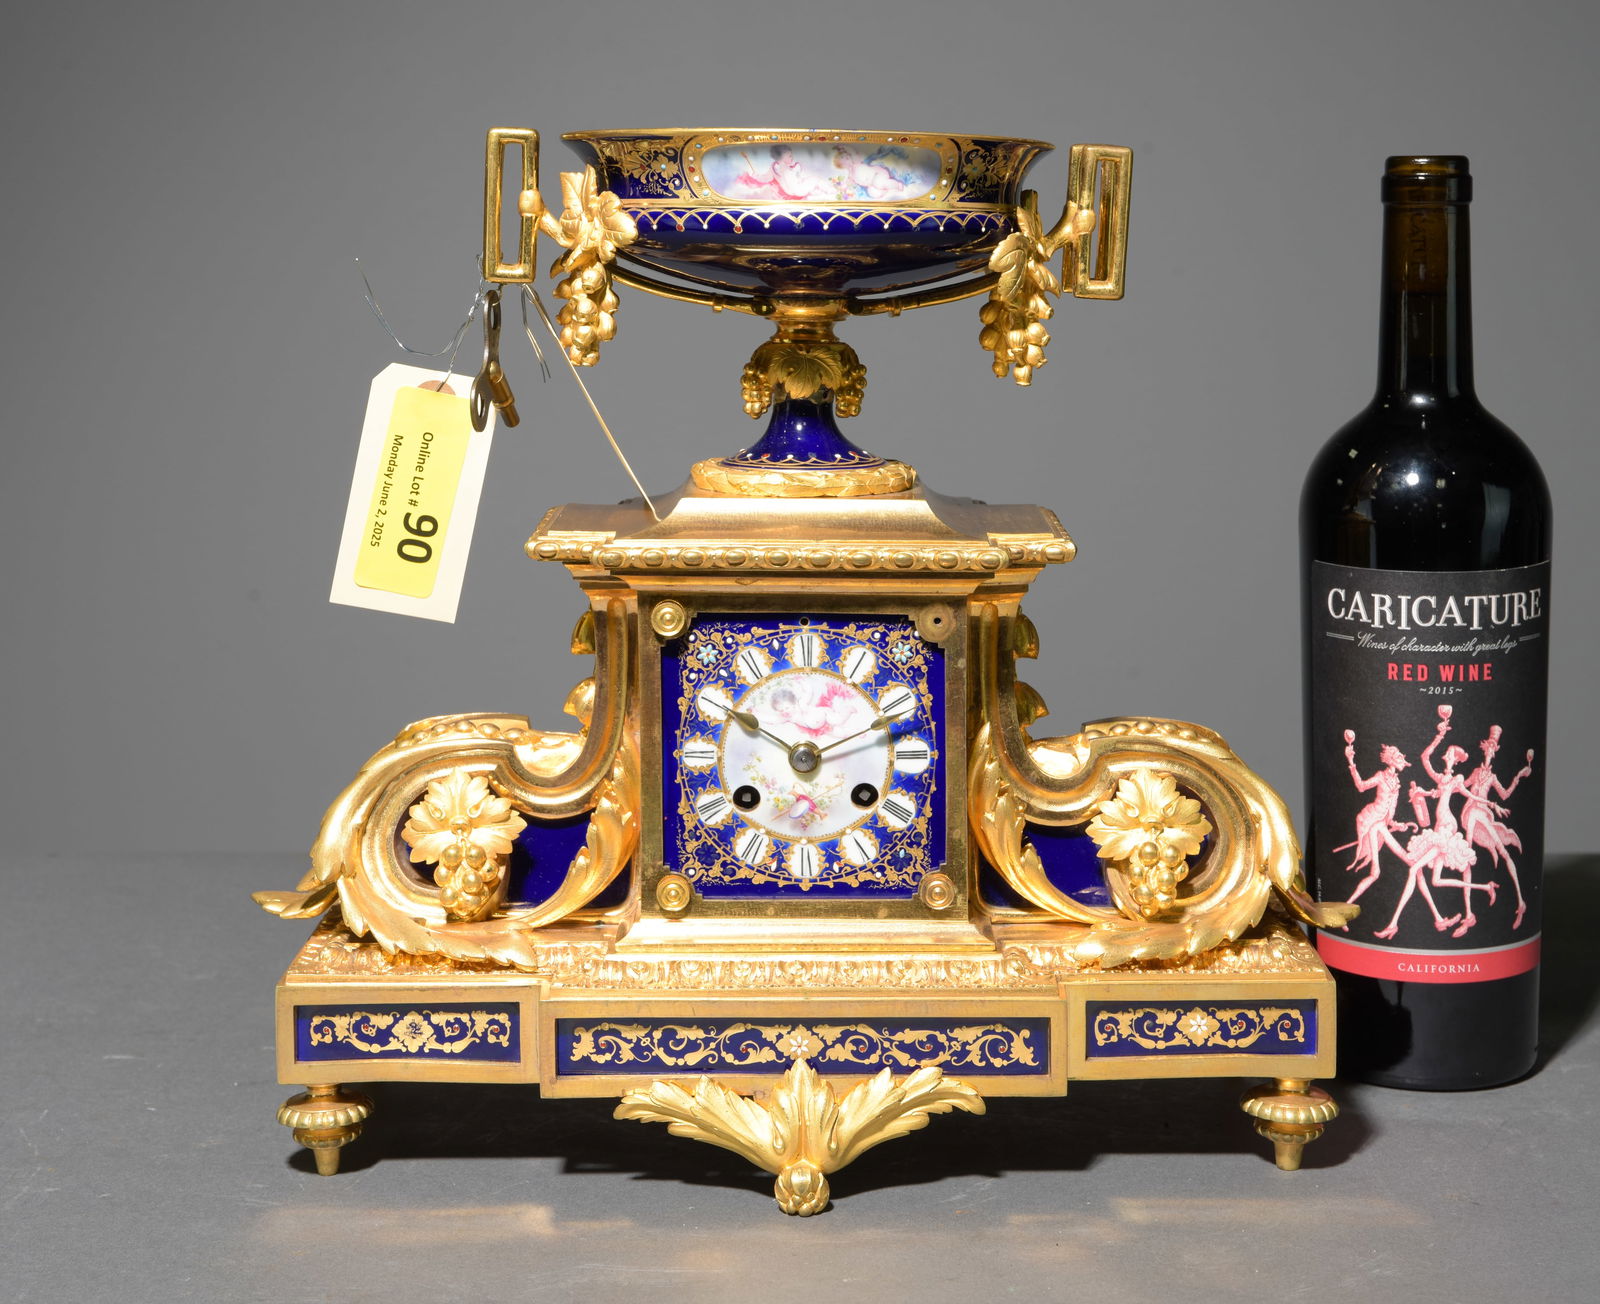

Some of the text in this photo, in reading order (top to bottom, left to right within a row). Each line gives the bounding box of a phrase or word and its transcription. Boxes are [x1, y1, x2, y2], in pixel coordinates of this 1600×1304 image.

[370, 434, 404, 547] Monday June 2, 2025
[397, 432, 439, 564] Online Lot # 90
[1327, 588, 1541, 630] CARICATURE
[1357, 631, 1517, 656] Wines of character with great legs
[1387, 662, 1493, 682] RED WINE
[1398, 962, 1481, 974] CALIFORNIA
